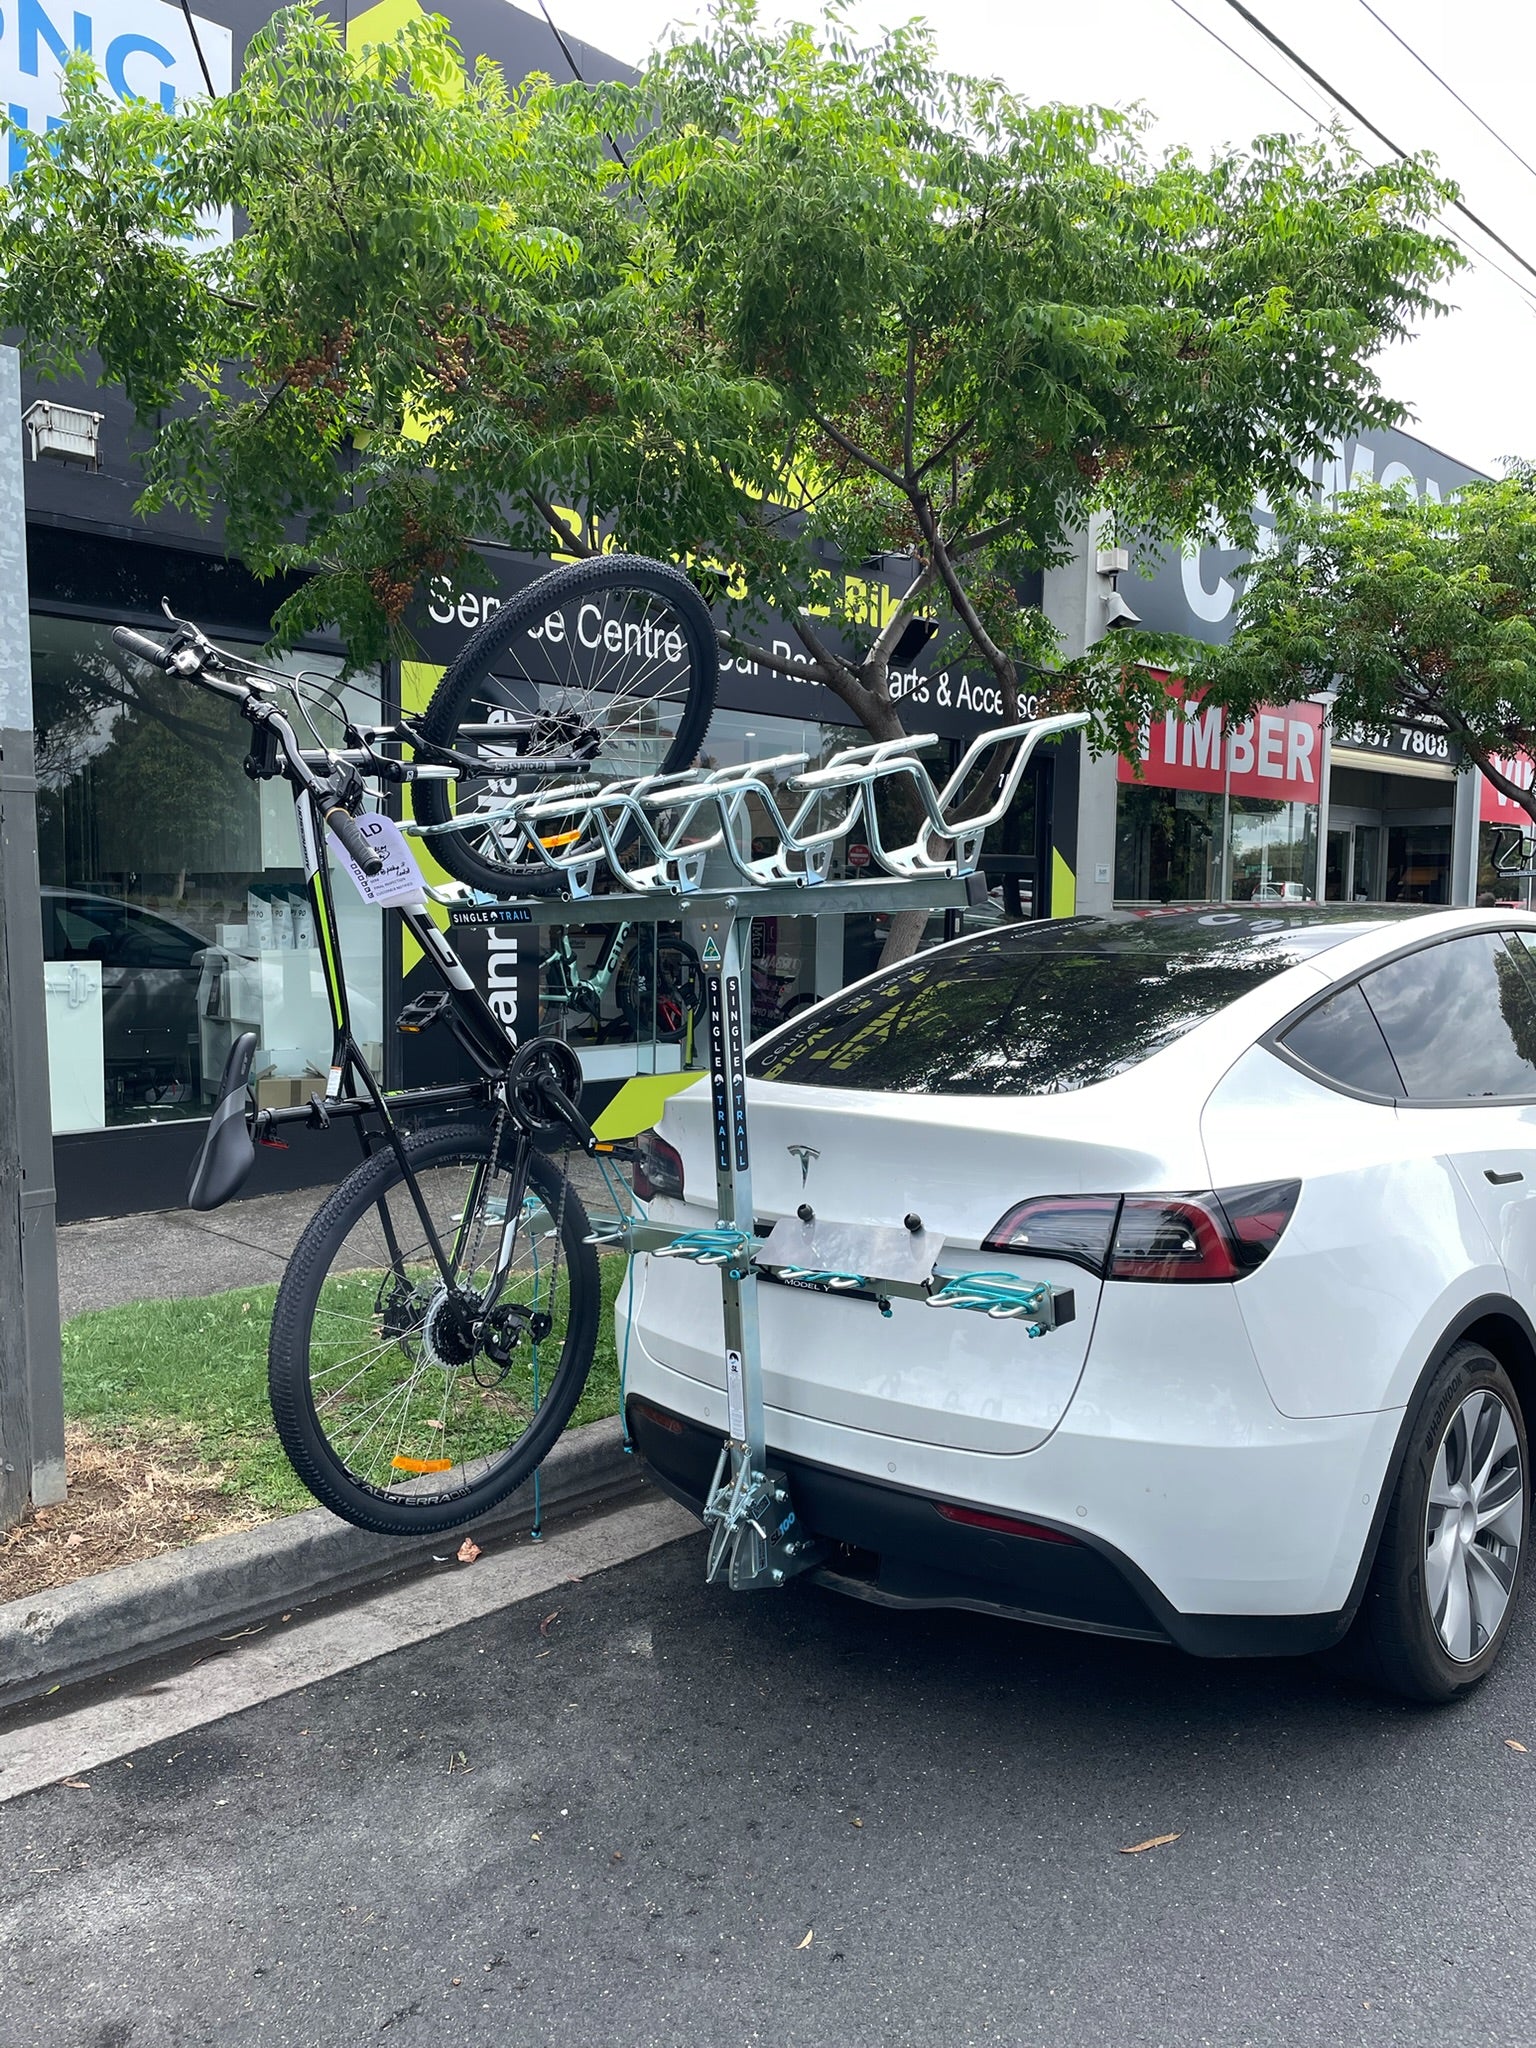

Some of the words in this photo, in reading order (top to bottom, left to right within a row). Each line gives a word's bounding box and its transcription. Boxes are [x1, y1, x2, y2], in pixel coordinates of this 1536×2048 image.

[0, 0, 177, 116] NG
[429, 575, 565, 642] Sere
[577, 603, 683, 662] Centre
[885, 667, 930, 703] arts
[936, 671, 952, 707] &
[360, 822, 383, 838] LD
[452, 911, 489, 923] SINGLE
[499, 910, 530, 921] TRAIL
[710, 980, 722, 1068] SINGLE
[729, 980, 741, 1068] SINGLE
[716, 1095, 727, 1167] TRAIL
[735, 1095, 746, 1167] TRAIL
[784, 1278, 821, 1291] MODEL
[822, 1283, 831, 1293] Y
[770, 1511, 796, 1547] SL100
